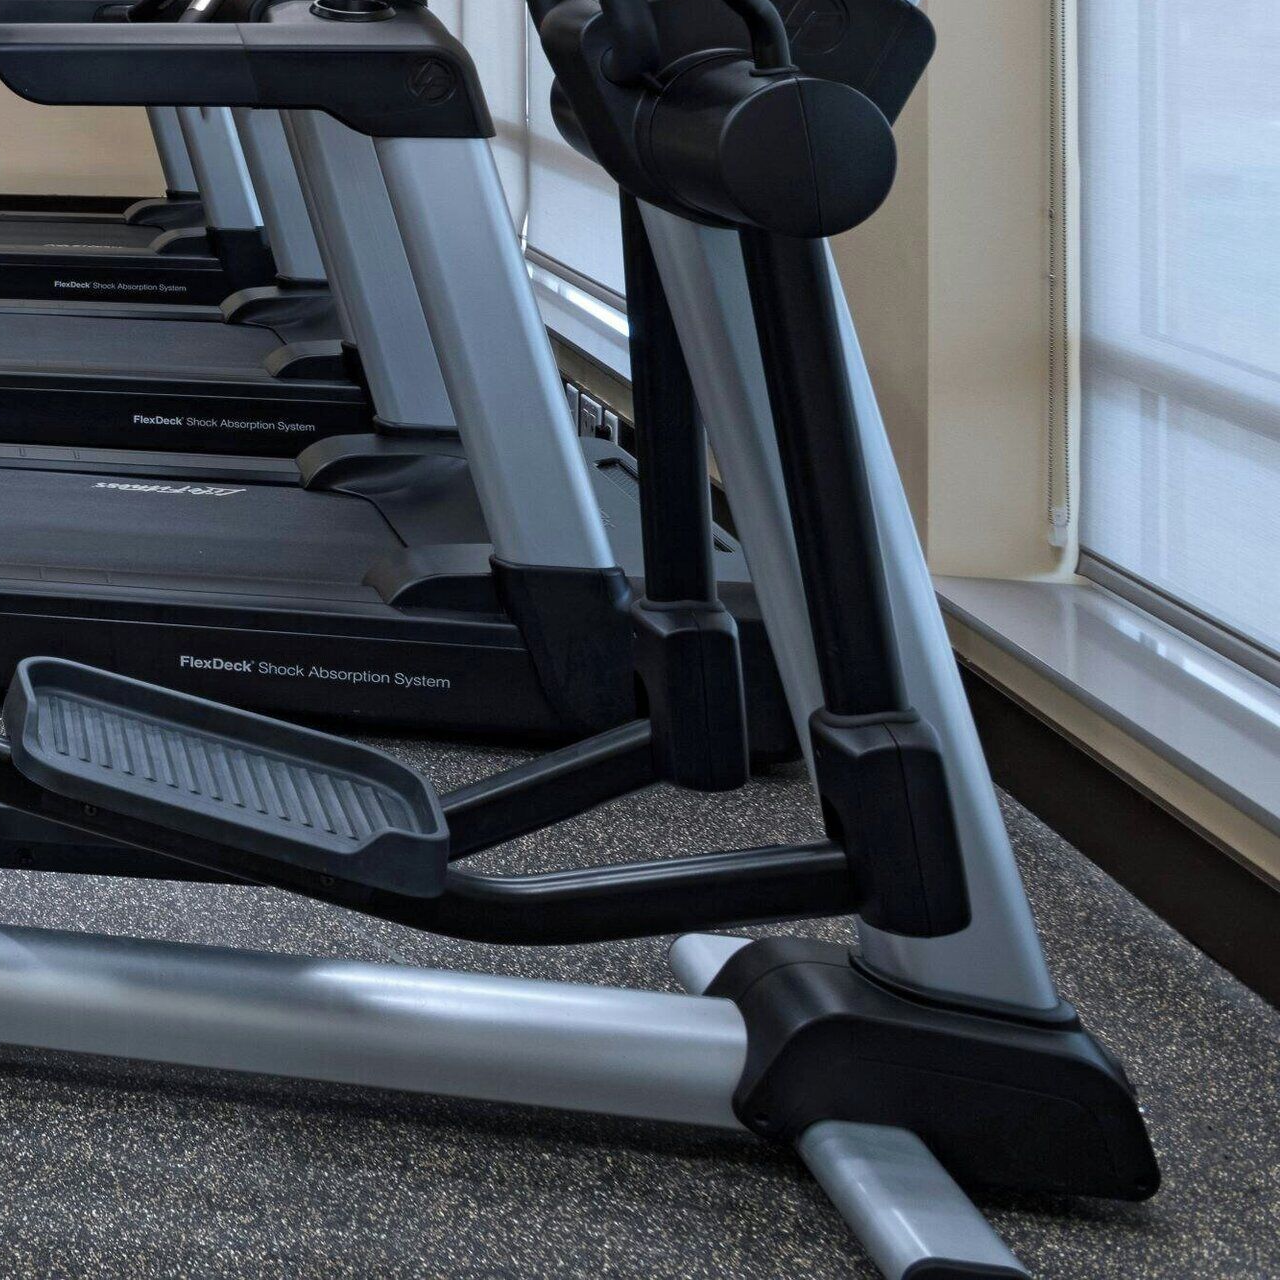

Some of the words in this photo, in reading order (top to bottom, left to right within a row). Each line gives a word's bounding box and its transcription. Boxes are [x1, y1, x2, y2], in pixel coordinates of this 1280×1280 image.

[54, 280, 90, 289] FlexDeck
[92, 281, 116, 290] Shock
[117, 282, 158, 291] Absorption
[159, 283, 187, 292] System
[133, 414, 182, 426] FlexDeck
[186, 417, 218, 428] Shock
[220, 419, 276, 431] Absorption
[277, 421, 316, 433] System
[180, 655, 252, 673] FlexDeck
[257, 661, 304, 678] Shock
[308, 666, 390, 685] Absorption
[394, 672, 451, 689] System
